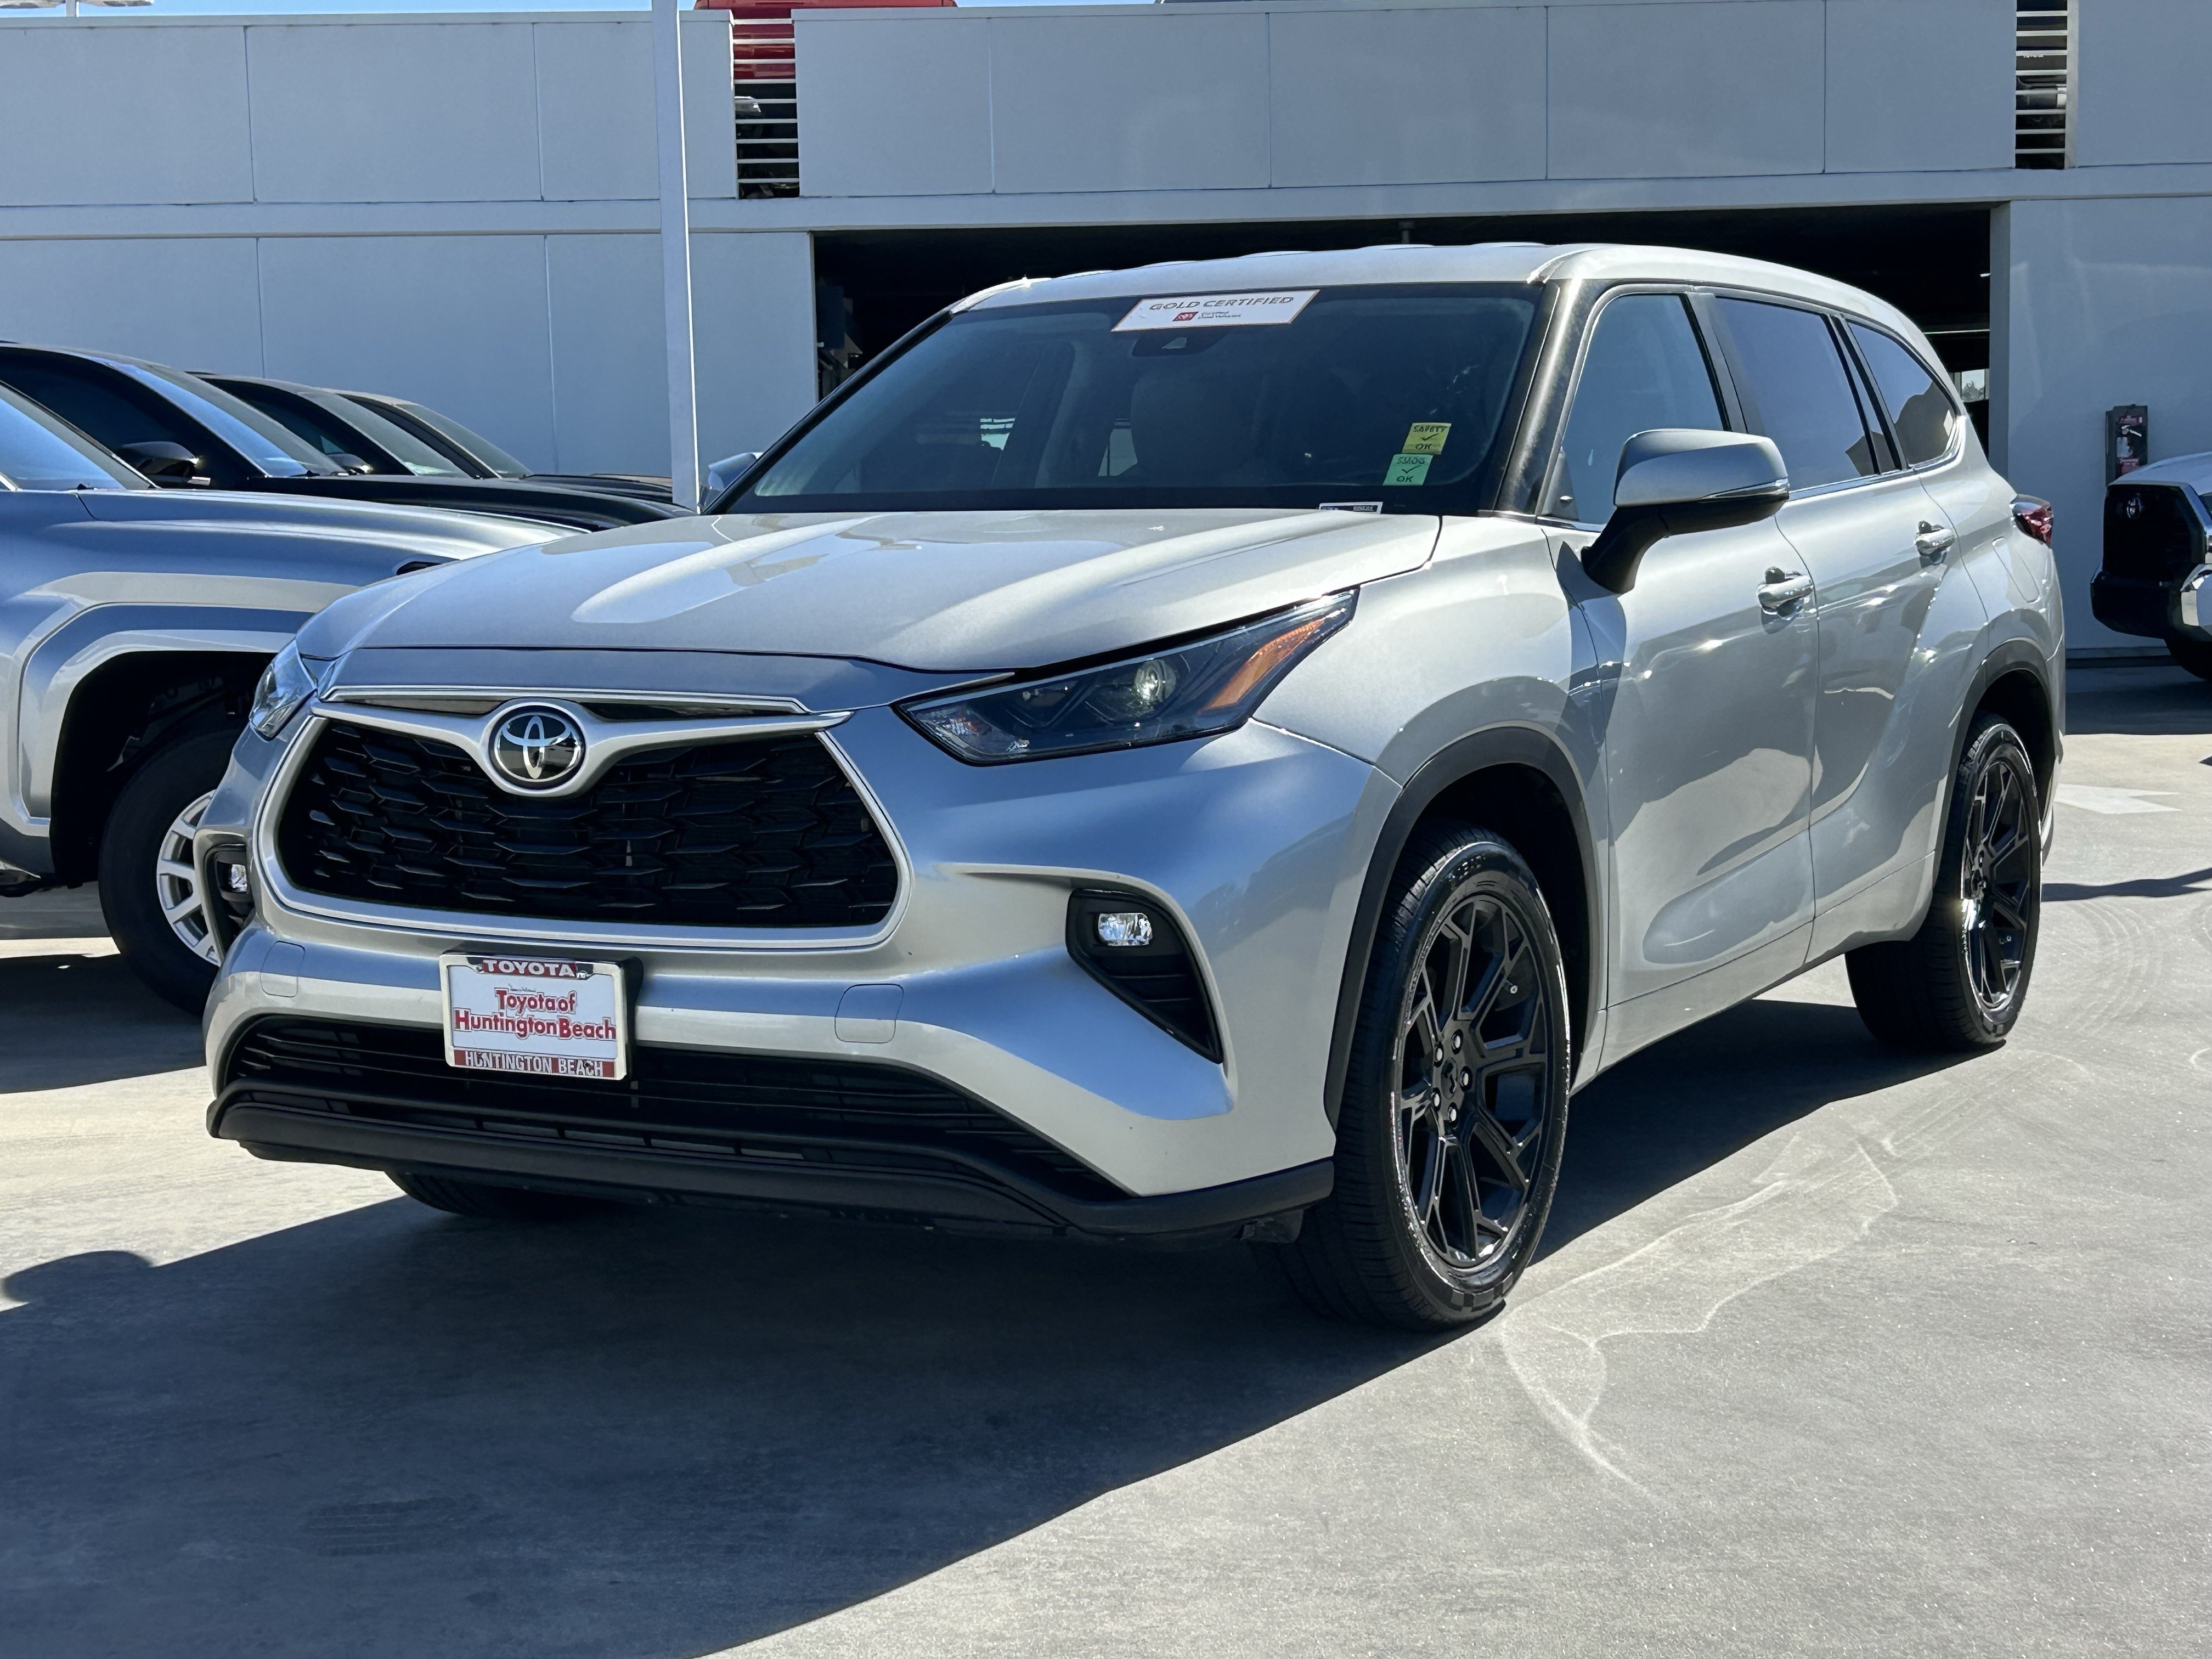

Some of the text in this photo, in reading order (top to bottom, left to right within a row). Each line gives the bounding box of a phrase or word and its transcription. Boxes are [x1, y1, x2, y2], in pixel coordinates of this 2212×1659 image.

[1149, 296, 1294, 311] GOLD CERTIFIED
[483, 960, 576, 977] TOYOTA
[455, 1009, 617, 1039] Huntington Beach
[465, 1051, 603, 1077] HUNTINGTON BEACH
